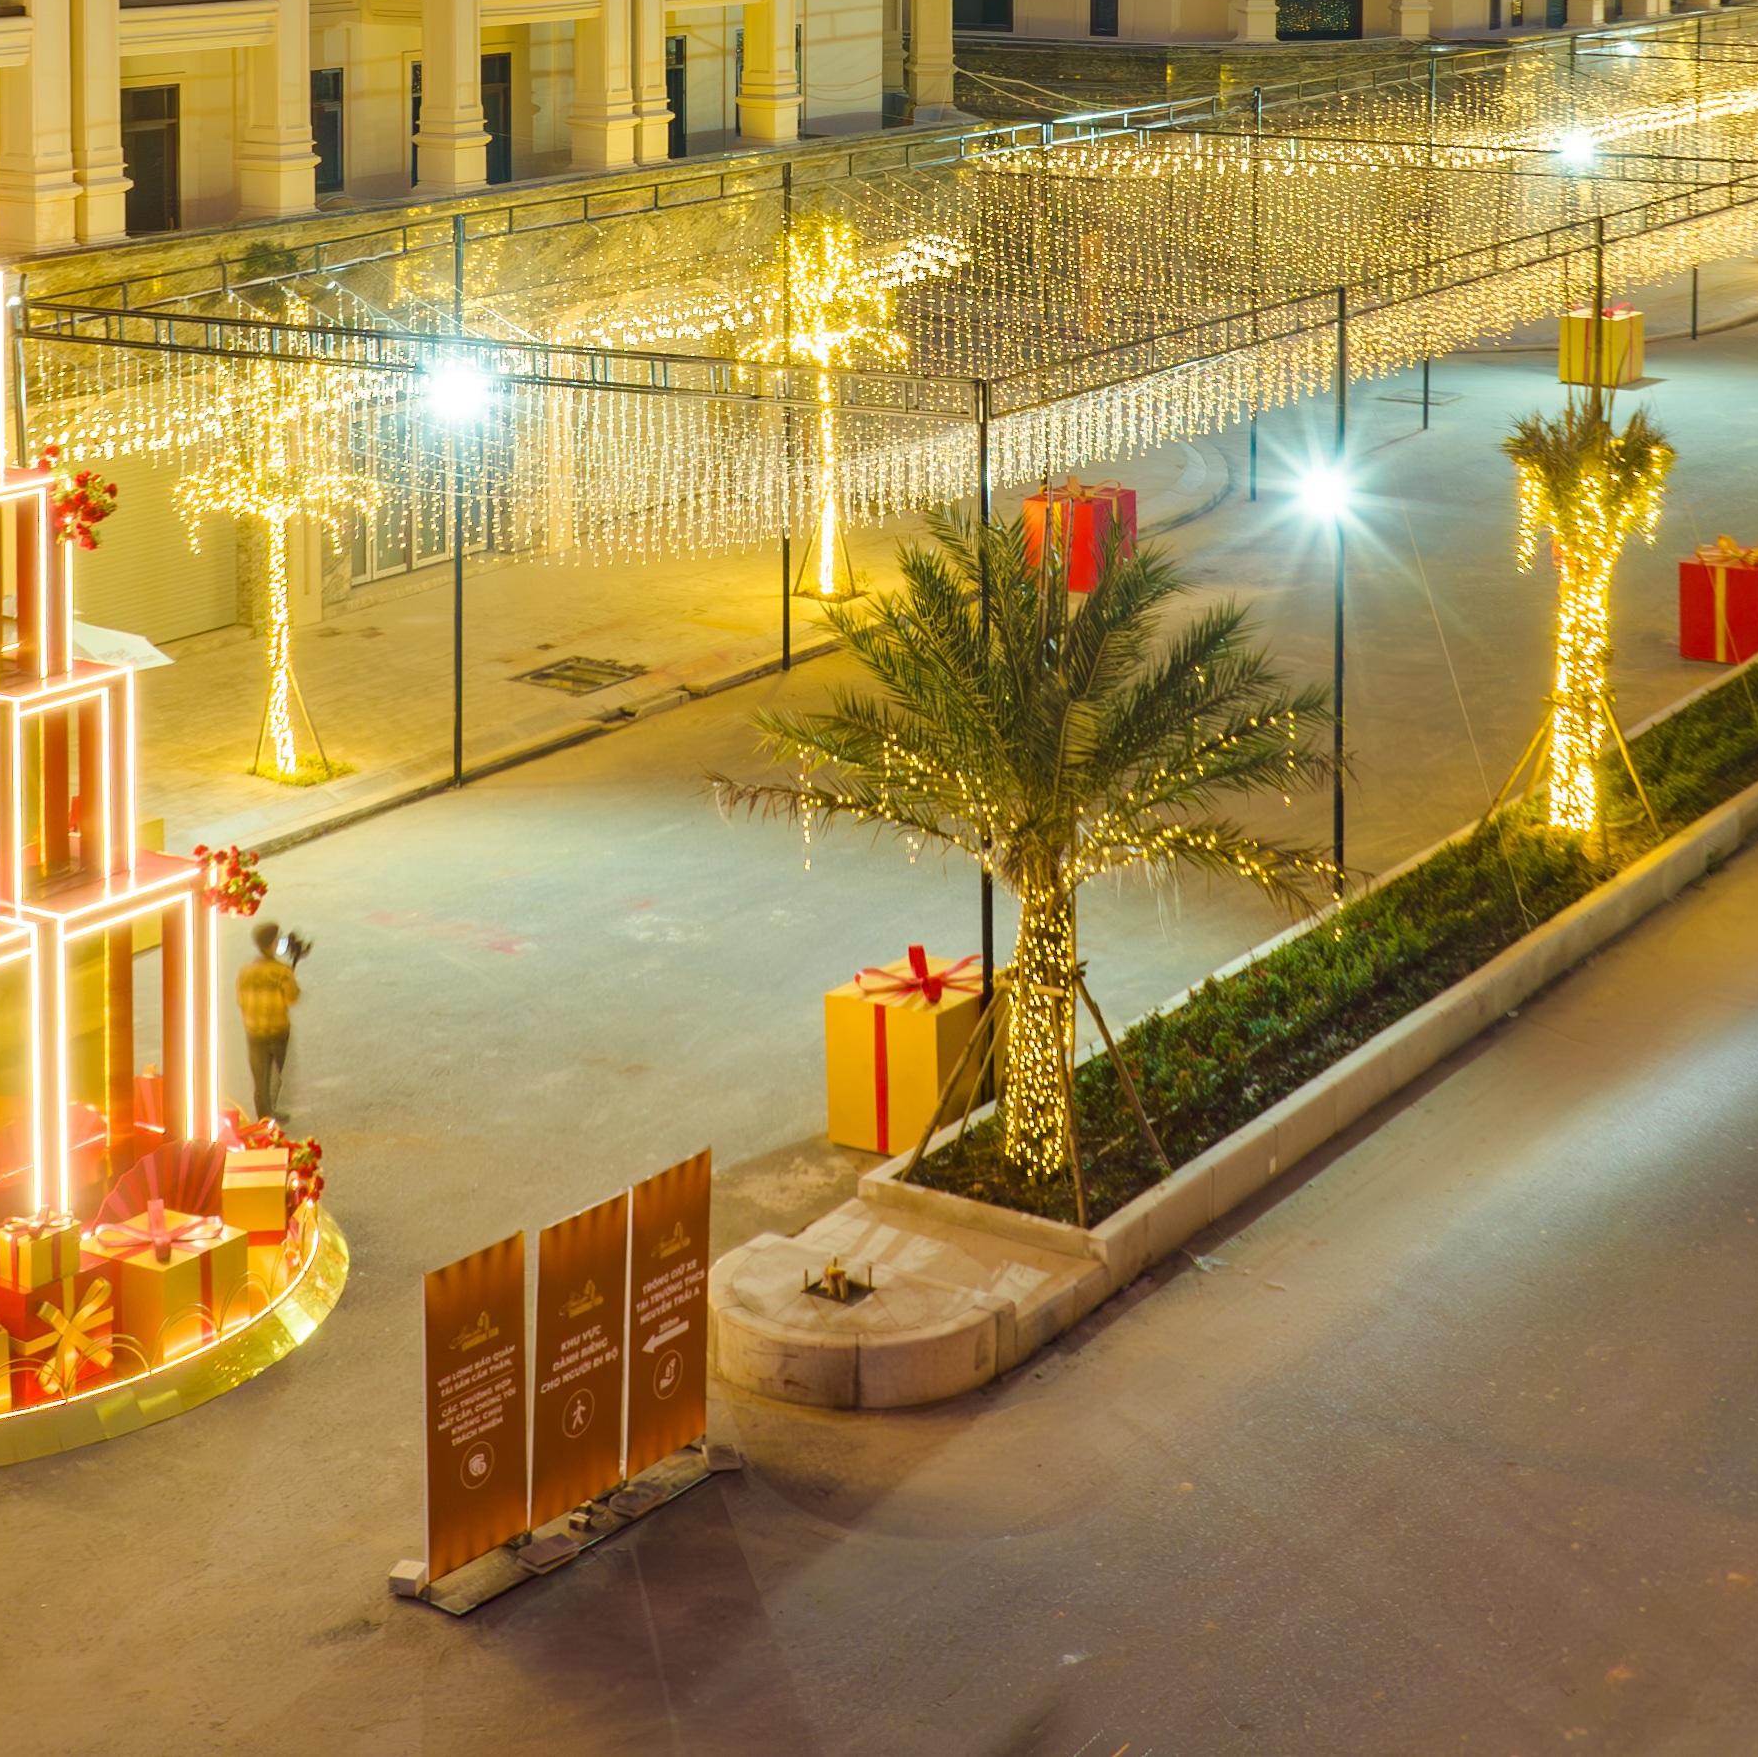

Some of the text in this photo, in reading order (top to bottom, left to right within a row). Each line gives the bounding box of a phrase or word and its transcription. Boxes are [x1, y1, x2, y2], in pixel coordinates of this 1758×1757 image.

[686, 1258, 698, 1272] XE
[693, 1285, 701, 1298] A
[560, 1324, 602, 1352] KHU VỰC
[540, 1377, 561, 1394] CHO
[562, 1360, 592, 1384] NGƯỜI
[604, 1344, 619, 1363] BỘ
[552, 1351, 580, 1373] DÀNH
[441, 1403, 459, 1418] CÁC
[450, 1417, 481, 1435] KHÔNG
